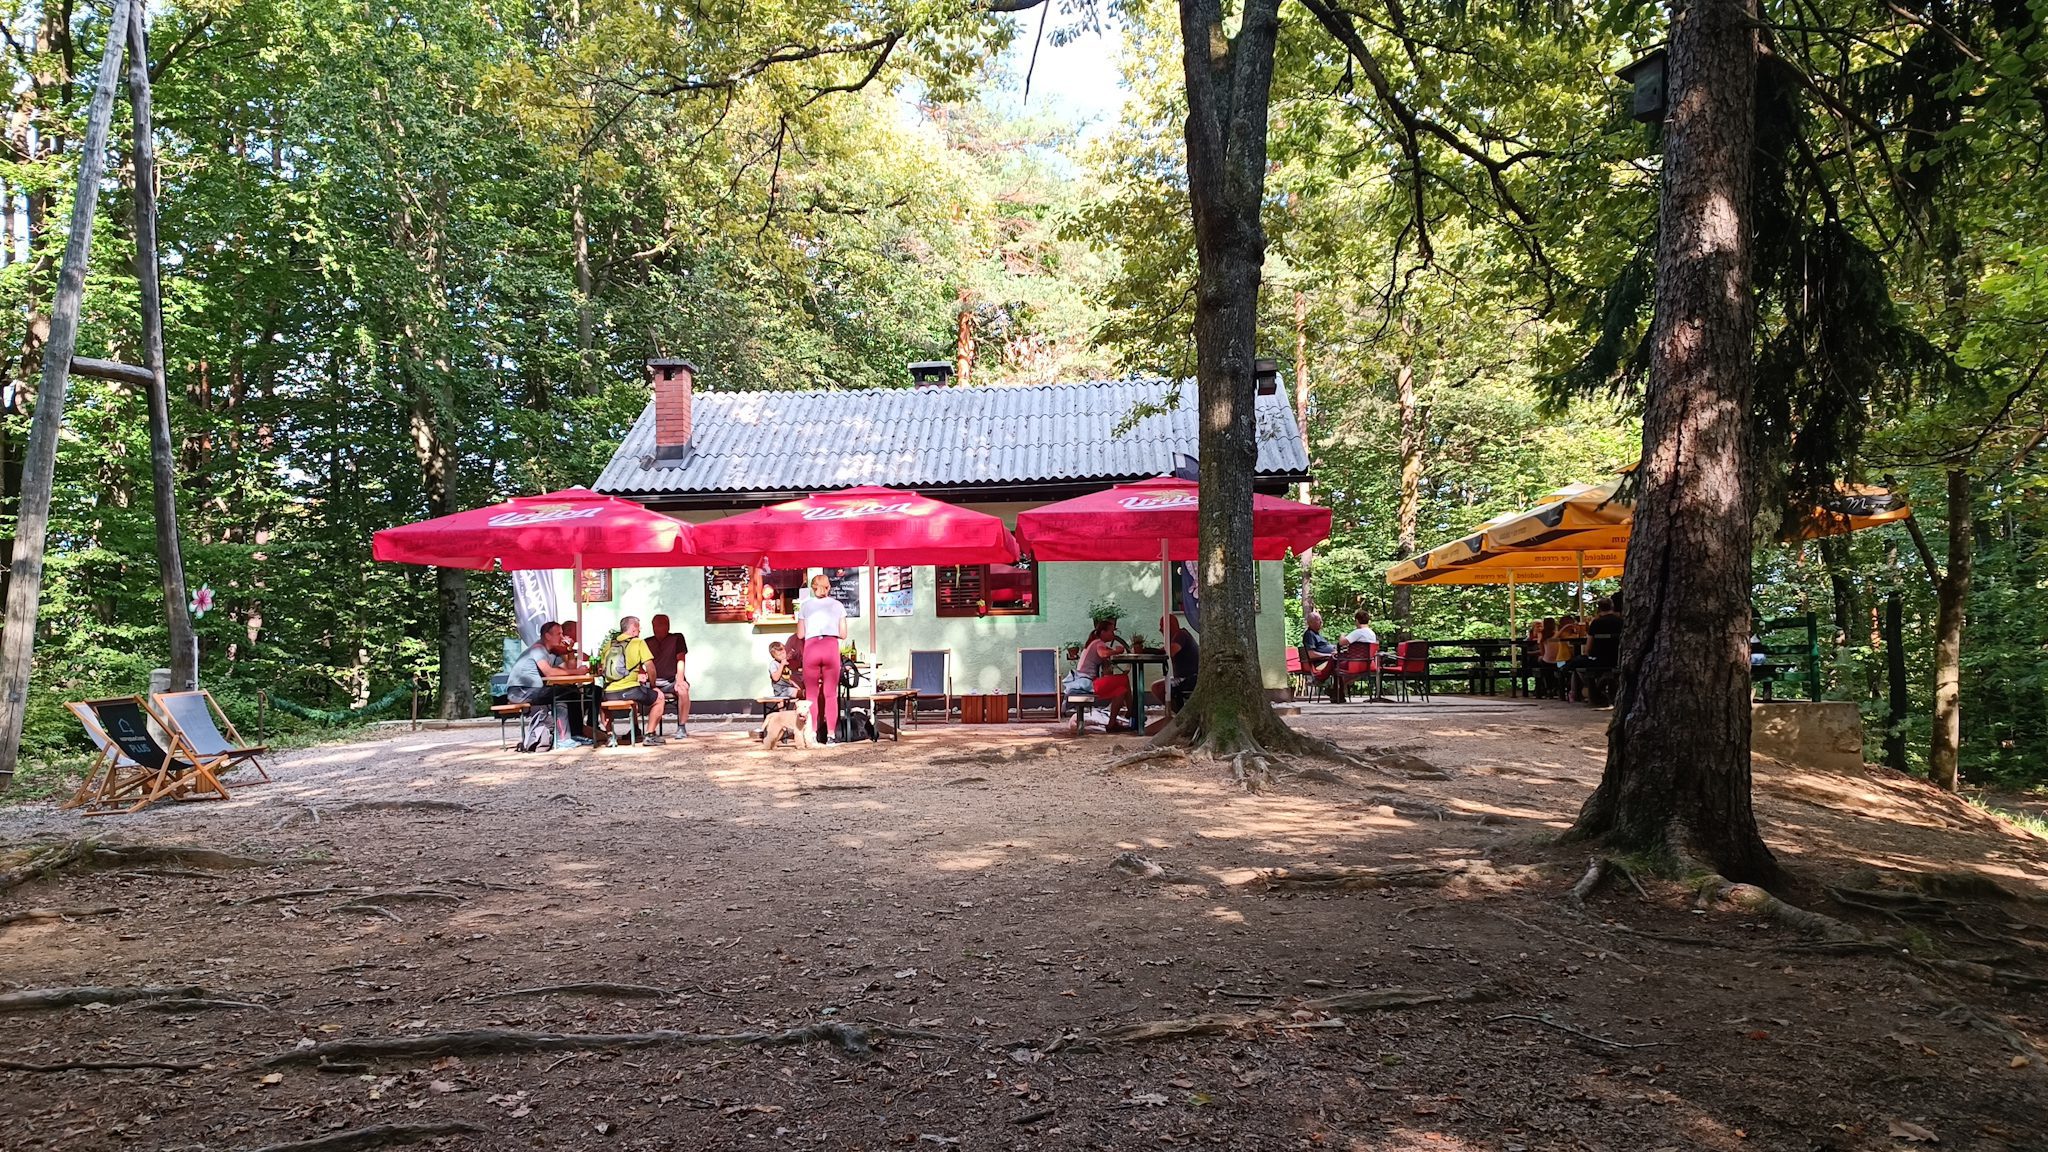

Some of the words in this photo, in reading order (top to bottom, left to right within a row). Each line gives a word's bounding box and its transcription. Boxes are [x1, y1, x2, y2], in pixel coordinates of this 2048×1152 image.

[801, 502, 912, 521] Union
[1117, 495, 1199, 512] Unio
[487, 507, 604, 527] Union
[128, 743, 151, 753] PLUS
